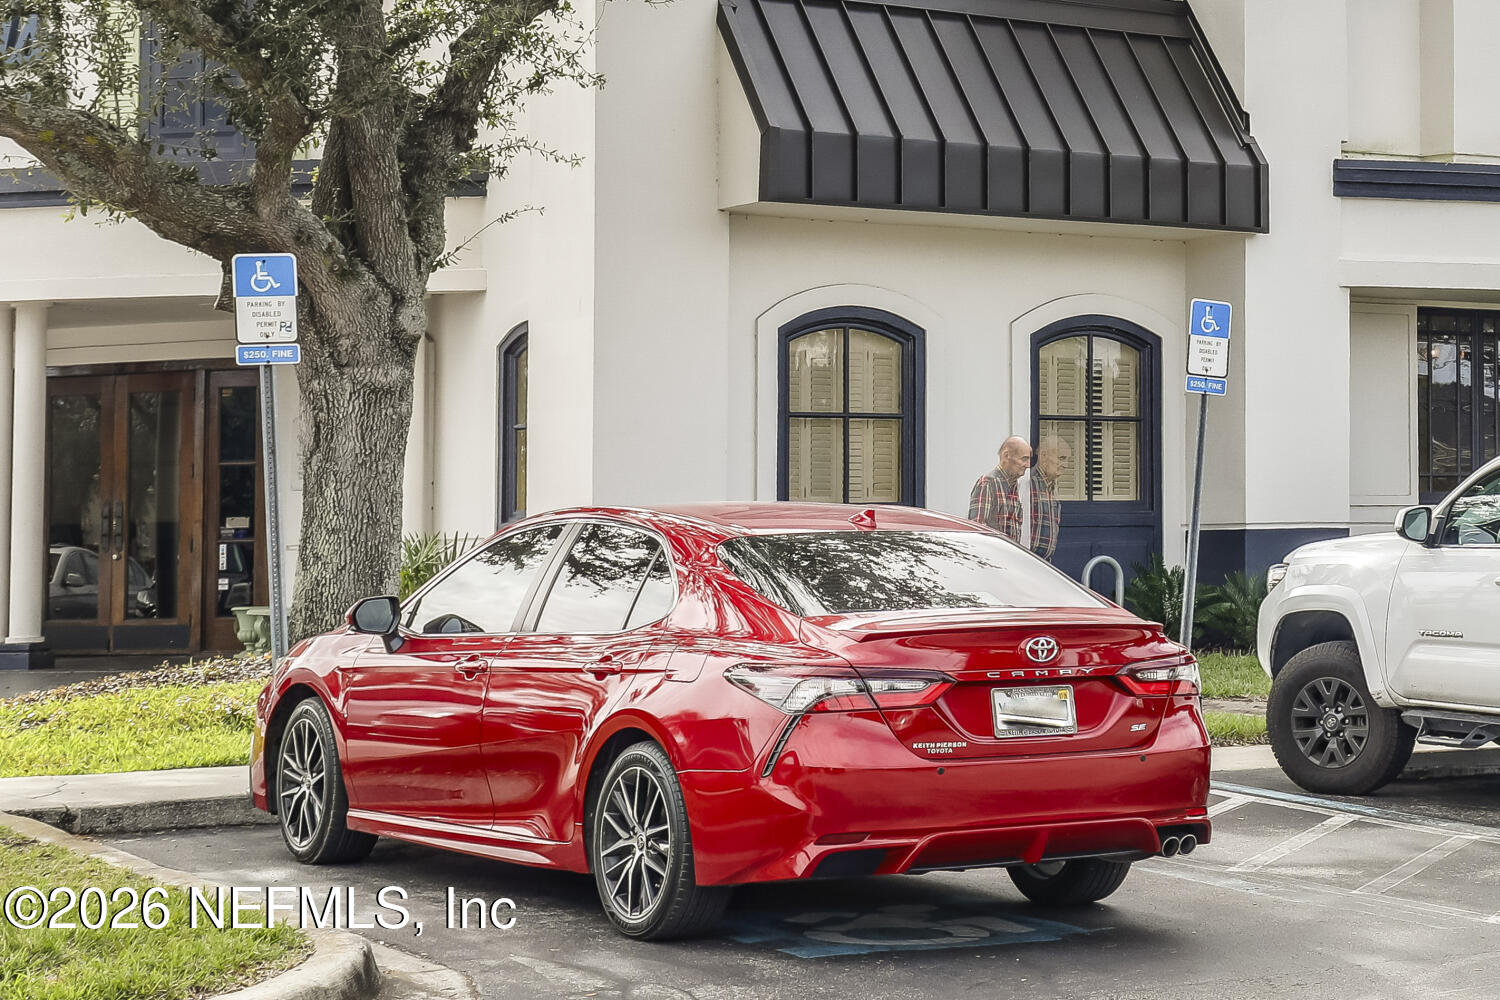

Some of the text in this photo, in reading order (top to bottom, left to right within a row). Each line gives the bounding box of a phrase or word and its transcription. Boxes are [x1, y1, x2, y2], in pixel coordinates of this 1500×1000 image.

[259, 331, 275, 339] ONLY
[243, 349, 294, 360] $250. FINE
[1208, 382, 1223, 391] FINE
[1418, 629, 1464, 639] TACOMA
[986, 667, 1095, 679] CAMRY
[1130, 723, 1147, 732] SE
